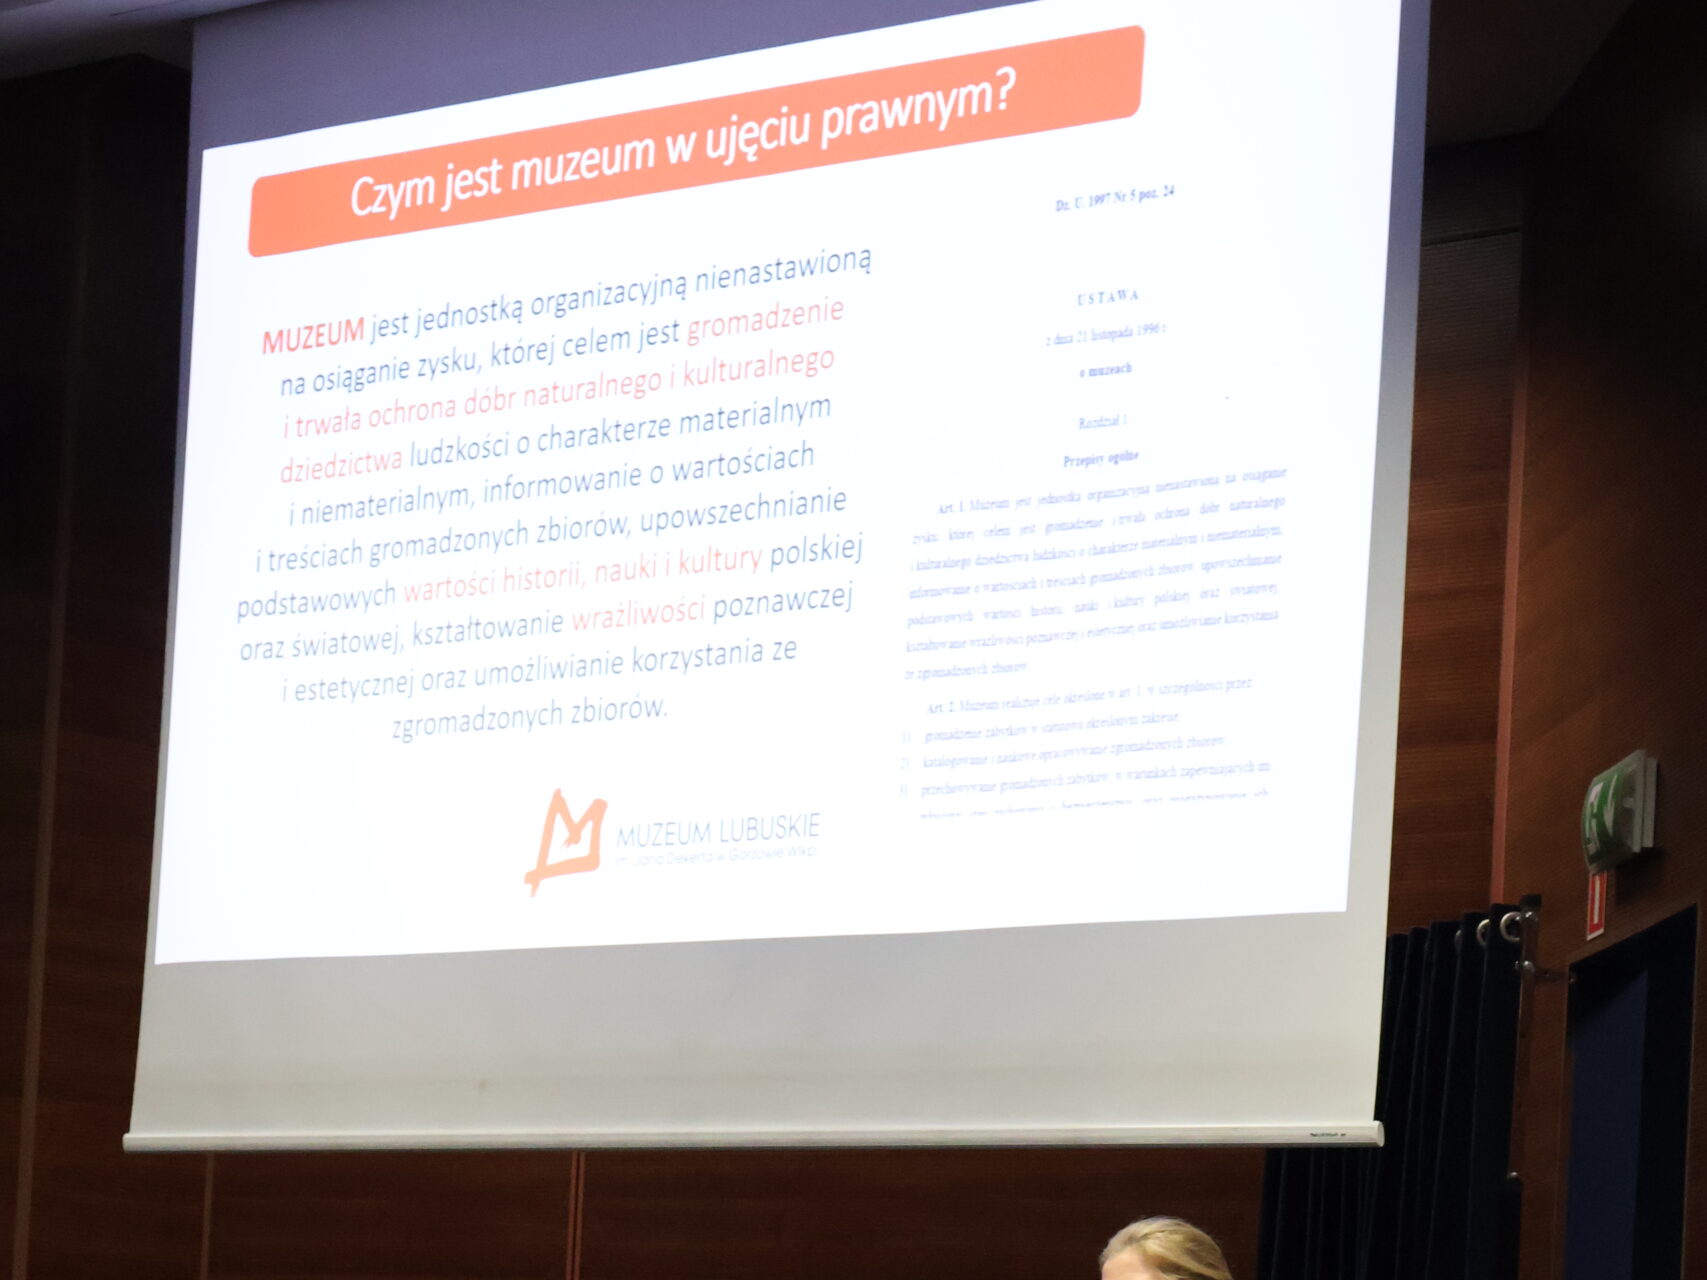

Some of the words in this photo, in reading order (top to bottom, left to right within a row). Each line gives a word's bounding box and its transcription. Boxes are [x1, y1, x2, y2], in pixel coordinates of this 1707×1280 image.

[352, 175, 435, 220] Czym
[441, 158, 503, 212] jest
[512, 138, 655, 190] muzeum
[666, 131, 697, 165] w
[707, 105, 810, 166] ujęciu
[821, 66, 1016, 150] prawnym?
[262, 316, 365, 355] MUZEUM
[368, 312, 410, 346] jest
[413, 294, 524, 339] jednostką
[530, 273, 688, 320] organizacyjną
[695, 248, 872, 292] nienastawioną
[280, 376, 306, 396] na
[312, 356, 411, 394] osiąganie
[416, 346, 483, 381] zysku,
[490, 334, 556, 367] której
[562, 327, 631, 358] celem
[636, 319, 681, 354] jest
[687, 297, 844, 347] gromadzenie
[295, 407, 361, 438] trwała
[368, 399, 456, 428] ochrona
[464, 386, 517, 415] dóbr
[524, 372, 662, 406] naturalnego
[683, 349, 835, 386] kulturalnego
[280, 451, 402, 483] dziedzictwa
[410, 432, 510, 467] ludzkości
[537, 417, 672, 452] charakterze
[679, 396, 832, 434] materialnym
[301, 485, 476, 525] niematerialnym,
[483, 463, 642, 503] informowanie
[671, 440, 815, 482] wartościach
[267, 539, 363, 572] treściach
[368, 519, 529, 569] gromadzonych
[536, 511, 631, 544] zbiorów,
[640, 486, 847, 537] upowszechnianie
[237, 580, 396, 624] podstawowych
[404, 574, 494, 604] wartości
[504, 562, 586, 592] historii,
[595, 554, 658, 585] nauki
[679, 546, 762, 574] kultury
[769, 531, 863, 573] polskiej
[239, 640, 285, 661] oraz
[291, 625, 404, 658] światowej,
[412, 610, 564, 647] kształtowanie
[572, 595, 705, 630] wrażliwości
[713, 580, 853, 625] poznawczej
[294, 668, 414, 703] estetycznej
[421, 669, 467, 691] oraz
[474, 651, 624, 687] umożliwianie
[632, 638, 764, 674] korzystania
[772, 640, 798, 661] ze
[392, 699, 563, 744] zgromadzonych
[570, 693, 668, 724] zbiorów.
[617, 821, 712, 848] MUZEUM
[719, 812, 821, 843] LUBUSKIE
